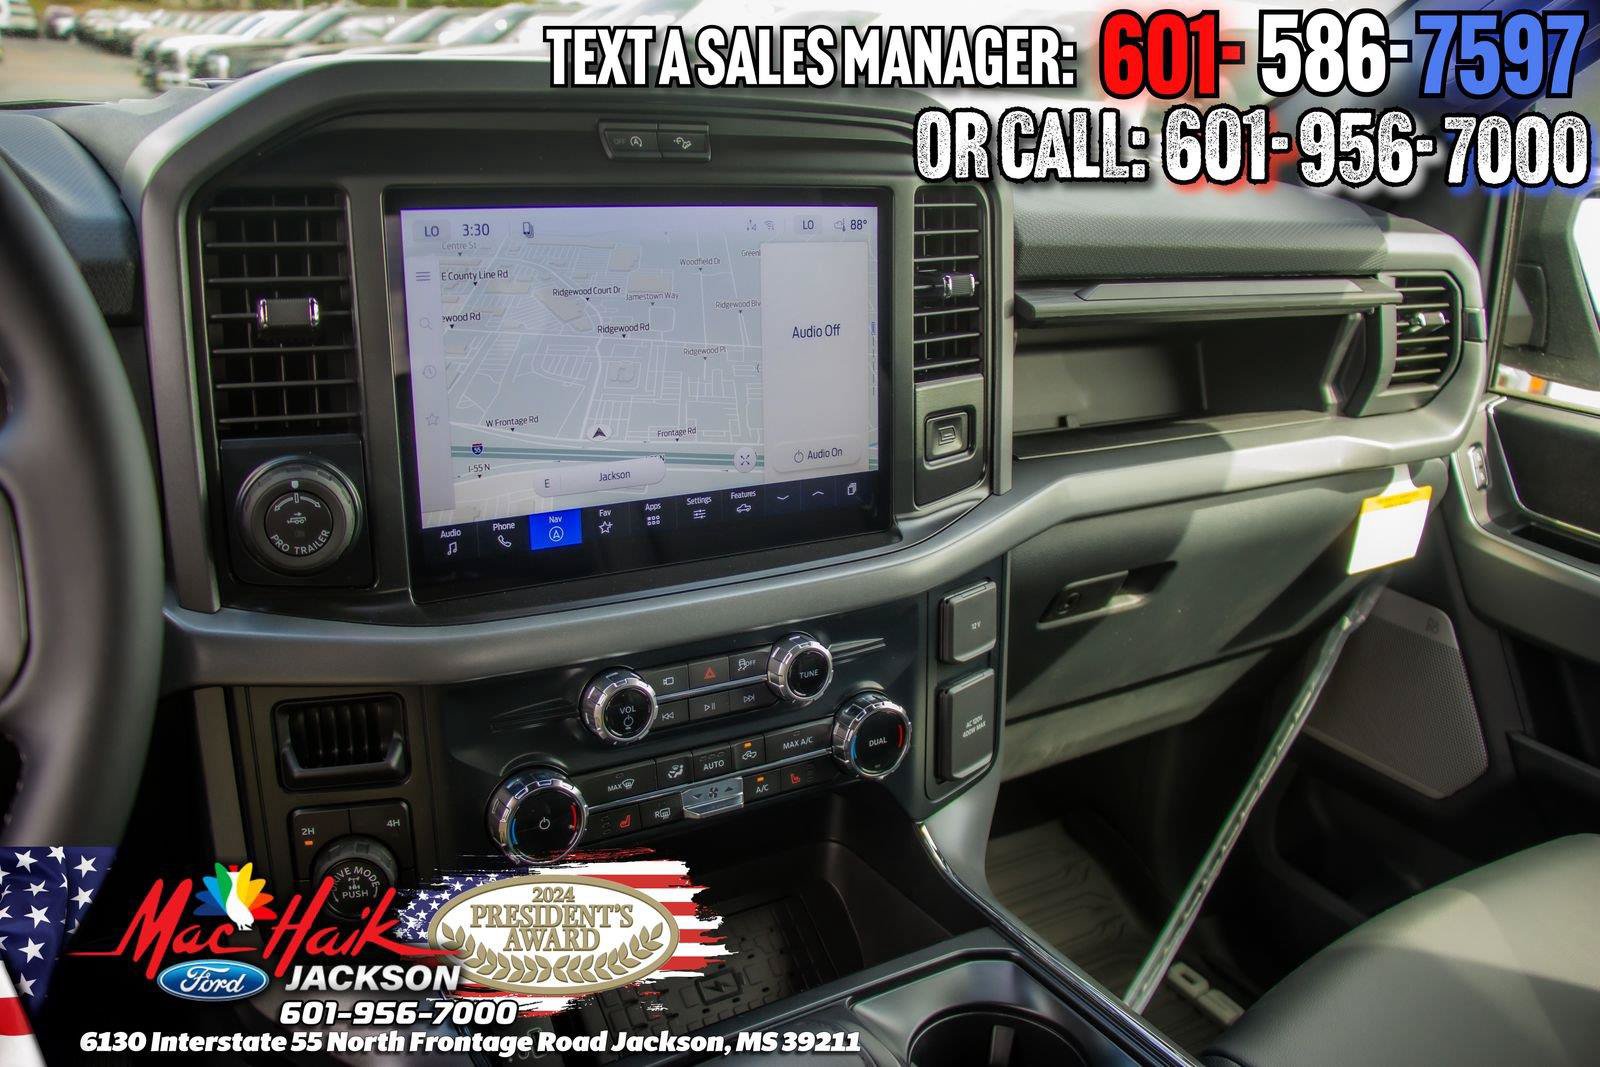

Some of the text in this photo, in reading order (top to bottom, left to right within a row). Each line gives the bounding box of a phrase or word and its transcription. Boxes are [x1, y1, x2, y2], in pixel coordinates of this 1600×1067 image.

[802, 219, 815, 230] LO
[424, 223, 490, 237] LO 3:30
[441, 241, 477, 250] Centre St
[680, 257, 721, 266] Woodfield Dr
[441, 270, 509, 283] E County Line Rd
[552, 286, 621, 298] Ridgewood Court Dr
[625, 292, 679, 301] Jamestown Way
[715, 300, 750, 309] Ridgewood
[469, 312, 481, 321] Rd
[597, 323, 650, 335] Ridgewood Rd
[792, 324, 841, 339] Audio Off
[683, 346, 718, 357] Ridgewood
[486, 415, 539, 428] W Frontage Rd
[657, 427, 697, 438] Frontage Rd
[807, 447, 843, 460] Audio On
[468, 464, 483, 473] I-55
[544, 470, 631, 488] E Jackson
[730, 490, 757, 499] Features
[686, 495, 712, 505] Settings
[645, 502, 661, 511] Apps
[599, 509, 612, 517] Fav
[549, 516, 562, 524] Nav
[492, 521, 516, 531] Phone
[440, 529, 462, 539] Audio
[270, 529, 331, 555] PRO TRAILER
[799, 668, 820, 679] TUNE
[619, 705, 637, 715] VOL
[782, 736, 815, 750] MAX A/C
[869, 736, 888, 747] DUAL
[703, 759, 725, 771] AUTO
[607, 783, 623, 792] MAX
[756, 783, 769, 794] A/C
[386, 819, 401, 828] 4H
[302, 827, 315, 836] 2H
[353, 866, 381, 888] MODE
[342, 889, 369, 899] PUSH
